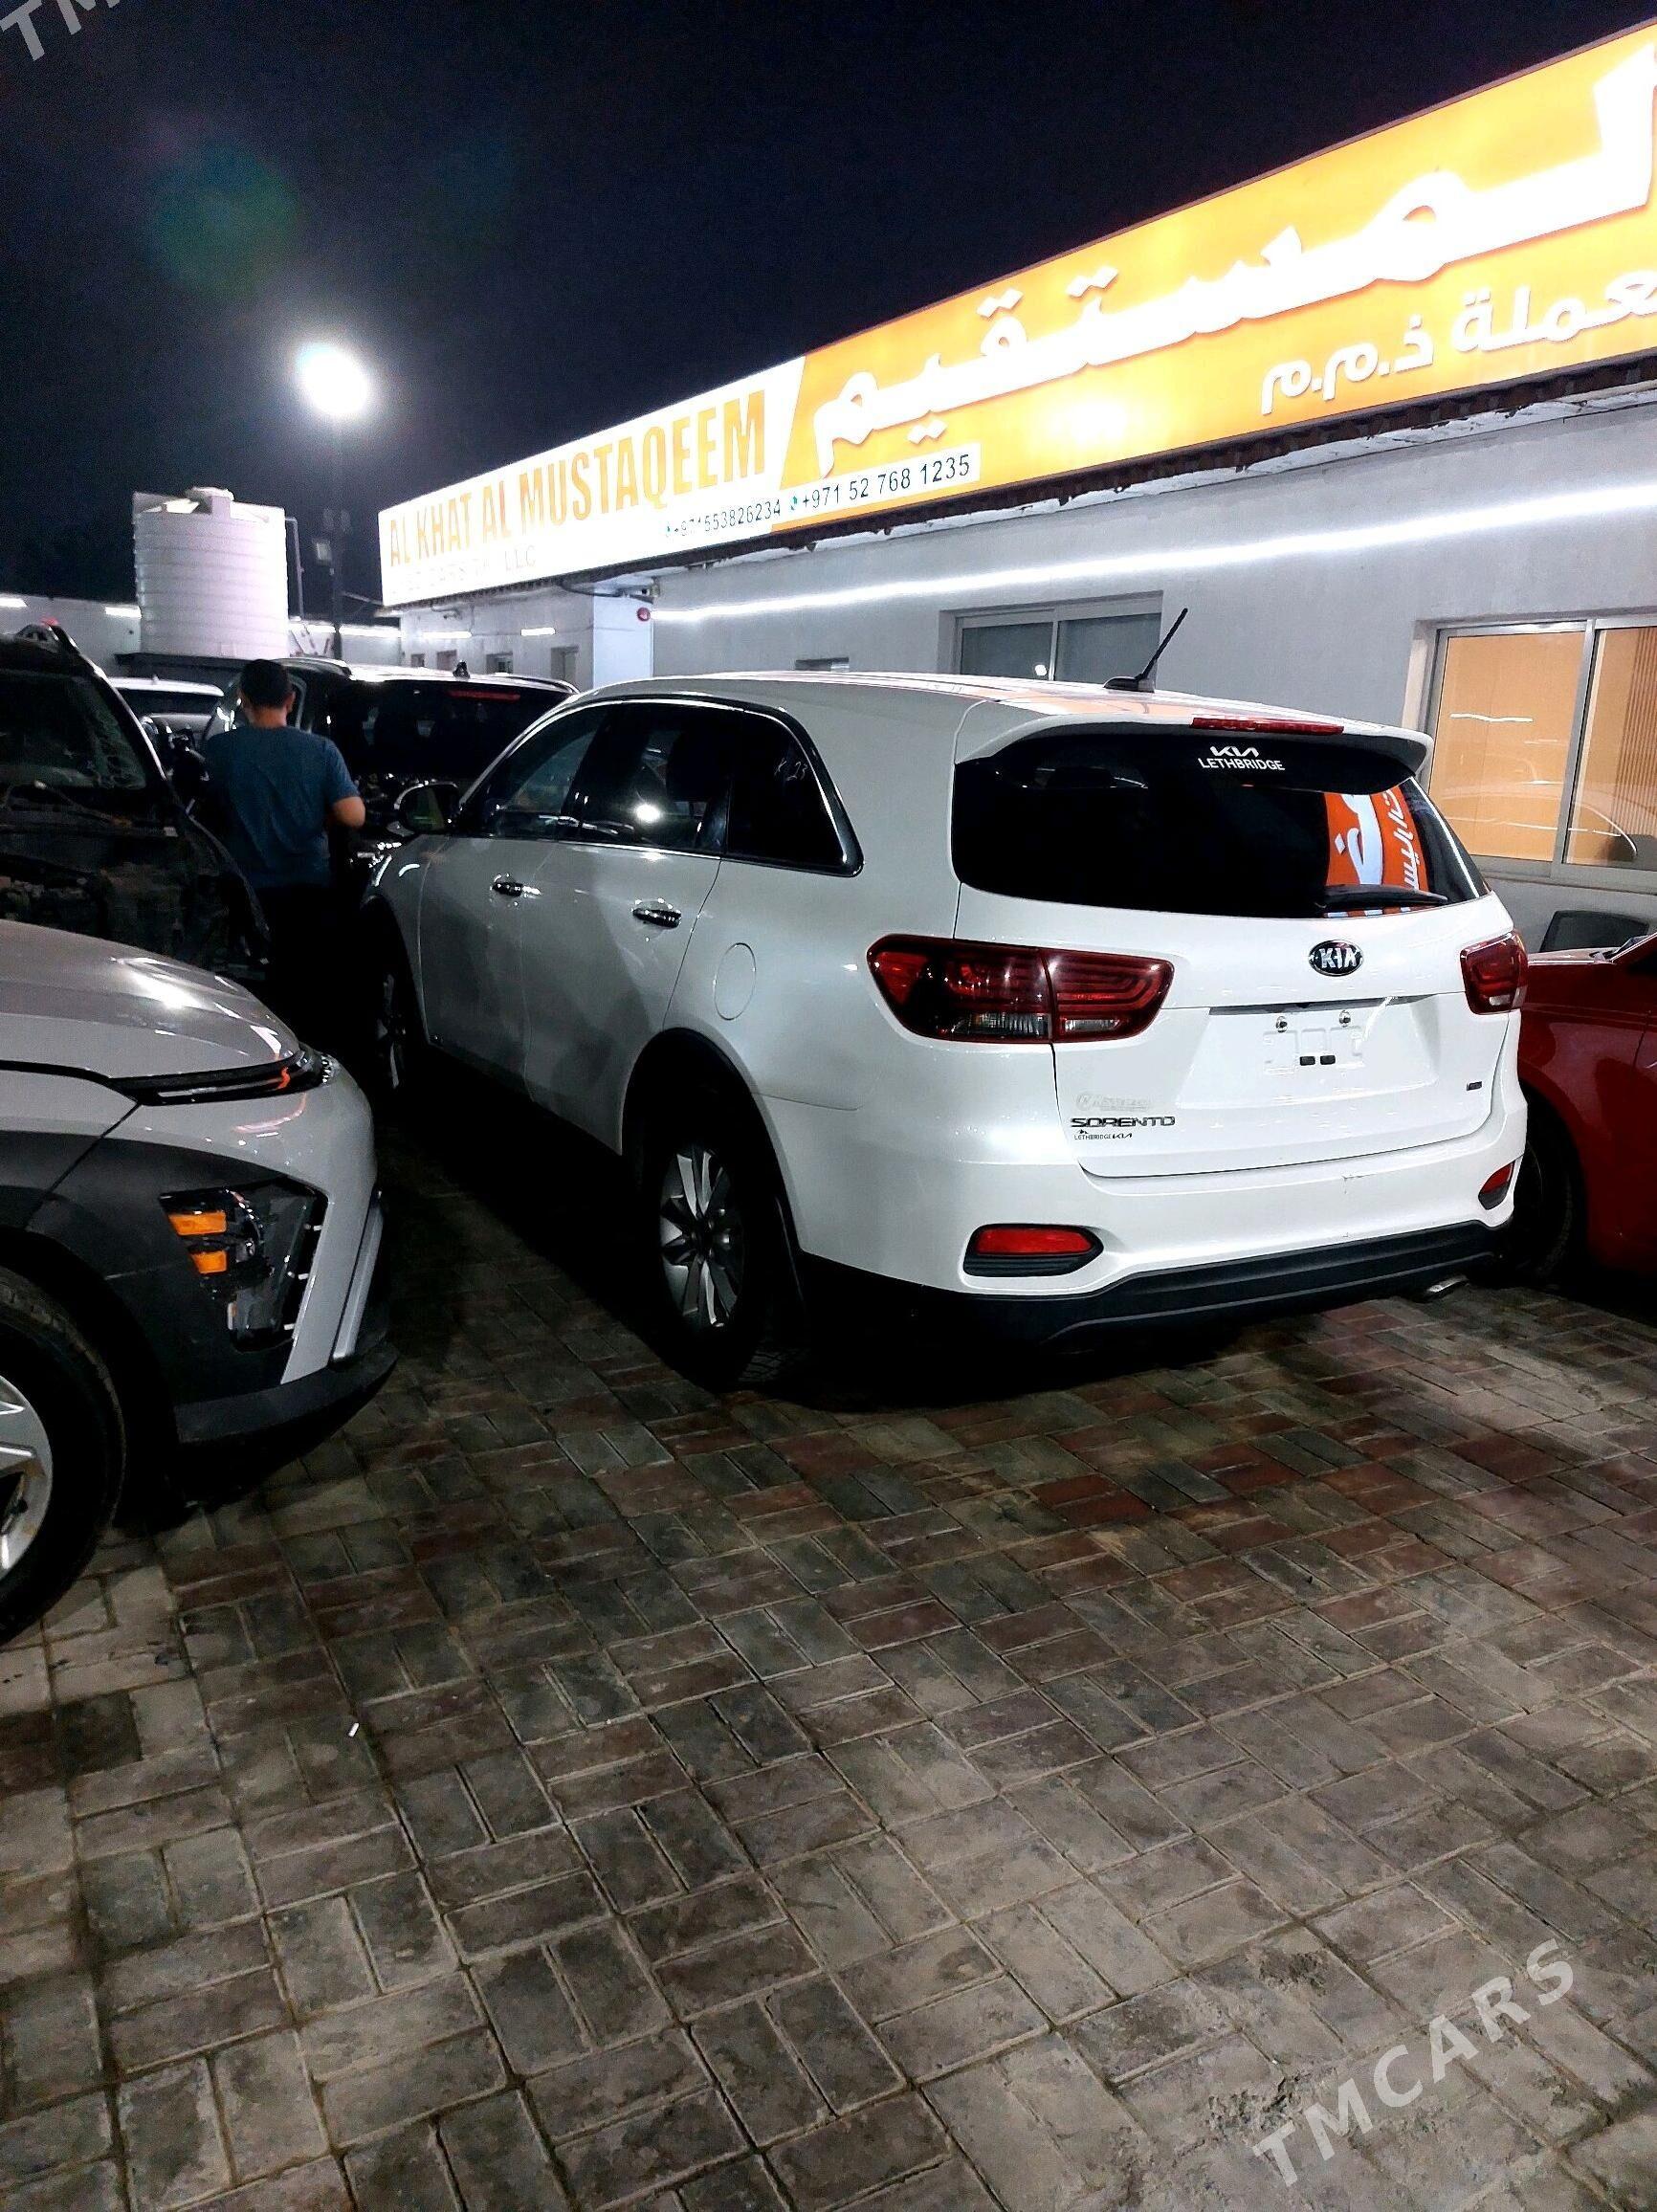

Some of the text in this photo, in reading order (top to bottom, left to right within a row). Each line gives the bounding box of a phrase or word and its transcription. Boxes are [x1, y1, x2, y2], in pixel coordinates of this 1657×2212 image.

[390, 390, 765, 567] AL KHAT AL MUSTAQEEM
[803, 453, 970, 509] +971 52 768 1235
[1198, 758, 1286, 770] LETHBRIDGE
[1319, 947, 1358, 969] KIA
[1071, 1116, 1176, 1128] SORENTO
